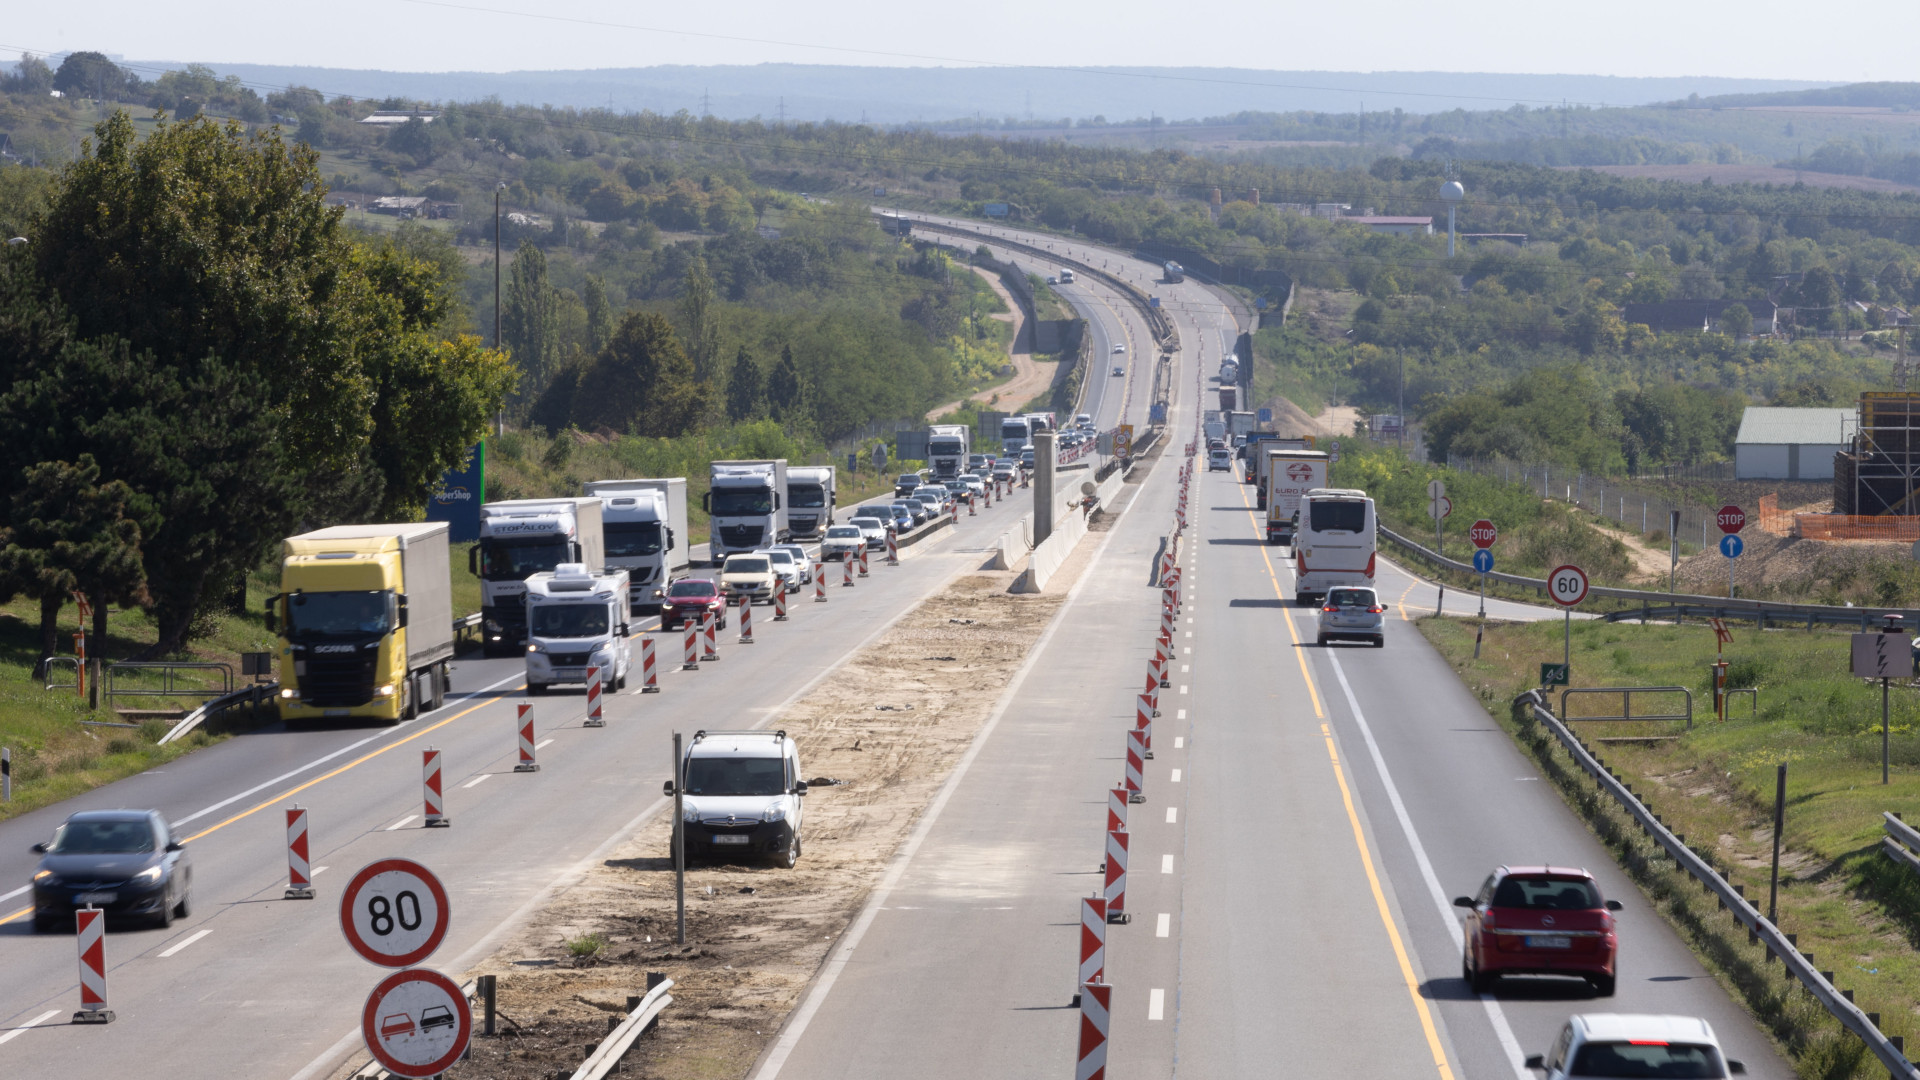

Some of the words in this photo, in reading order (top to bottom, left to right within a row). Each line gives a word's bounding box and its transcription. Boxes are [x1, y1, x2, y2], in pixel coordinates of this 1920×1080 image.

[1718, 514, 1745, 525] STOP
[1471, 528, 1496, 540] STOP
[1558, 577, 1579, 594] 60
[314, 644, 356, 654] SCANIA
[368, 890, 422, 936] 80
